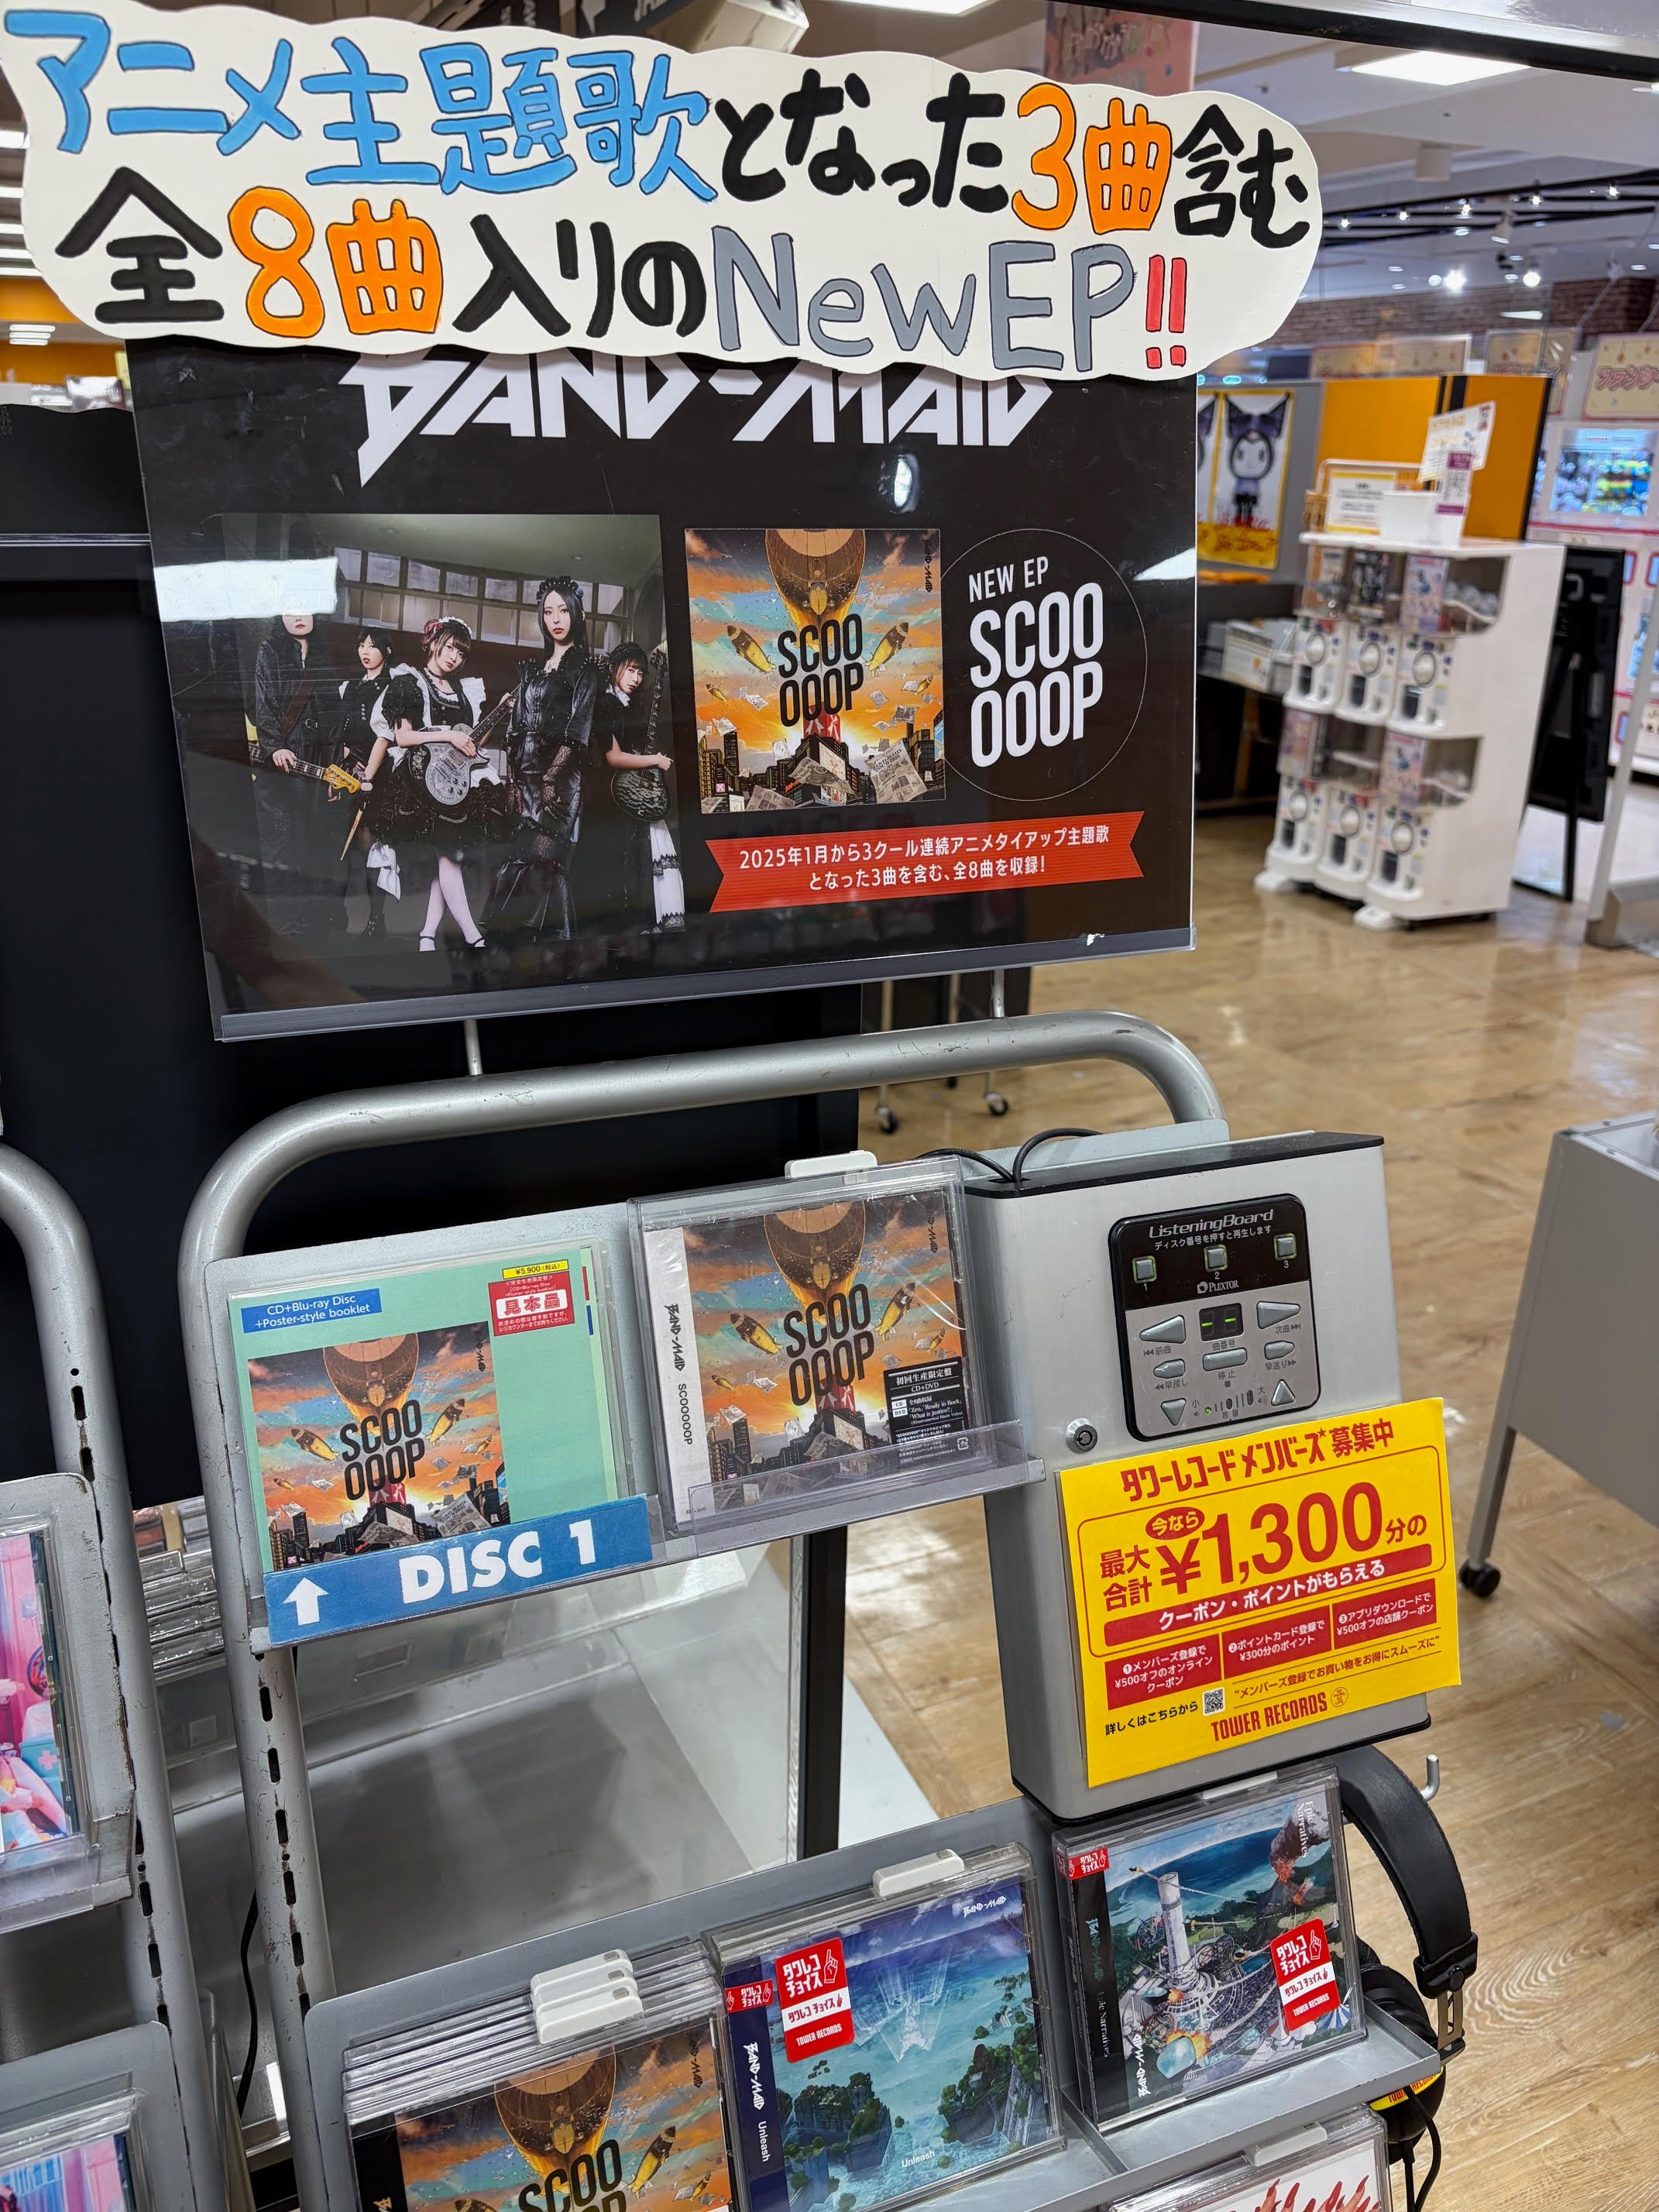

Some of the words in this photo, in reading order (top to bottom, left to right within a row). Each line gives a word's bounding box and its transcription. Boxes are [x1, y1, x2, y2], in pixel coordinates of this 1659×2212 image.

[4, 9, 1310, 249] アニメ主題歌となった3曲含む
[968, 564, 1015, 603] NEW
[1024, 555, 1049, 589] EP
[777, 613, 864, 678] SCOO
[970, 582, 1104, 689] SCOO
[780, 662, 864, 727] OOOP
[970, 661, 1104, 768] OOOP
[740, 825, 1110, 870] 2025年1月から3クール連続アニメタイアップ主題歌
[809, 860, 1046, 891] となった3曲を含む、全8曲を収録!
[1149, 1208, 1274, 1239] ListeningBoard
[1154, 1224, 1271, 1251] ディスク番号を押すと再生します
[1214, 1271, 1220, 1280] 2
[1283, 1260, 1289, 1269] 3
[1143, 1283, 1148, 1291] 1
[1208, 1279, 1239, 1292] PLEXTOR
[255, 1310, 325, 1328] +Poster-style
[329, 1304, 370, 1318] booklet
[266, 1298, 329, 1315] CD+Blu-ray
[332, 1295, 356, 1306] Disc
[504, 1292, 560, 1316] 見本品
[783, 1284, 871, 1358] SCOO
[1275, 1324, 1290, 1334] 次曲
[1155, 1345, 1171, 1355] 前曲
[1212, 1340, 1235, 1351] 曲番号
[664, 1304, 685, 1372] BAND-MAID
[678, 1383, 693, 1445] SCOOOOOP
[788, 1331, 874, 1406] OOOP
[896, 1367, 953, 1386] 初回生産限定盤
[1265, 1360, 1287, 1371] 早送り
[911, 1382, 939, 1393] CD+DVD
[1164, 1379, 1187, 1389] 早戻し
[1258, 1386, 1266, 1395] 大
[1192, 1399, 1200, 1408] 小
[340, 1399, 422, 1462] SCOO
[343, 1437, 426, 1501] OOOP
[1152, 1510, 1202, 1539] 今なら
[398, 1531, 543, 1605] DISC
[569, 1519, 596, 1565] 1
[1100, 1544, 1151, 1579] 最大
[1103, 1575, 1152, 1612] 合計
[1159, 1559, 1385, 1631] クーポン・ポイントがもらえる
[1337, 1604, 1434, 1636] ¥500オフの店舗クーポン
[1240, 1636, 1315, 1661] ¥300分のポイント
[1115, 1656, 1213, 1688] ¥500オフのオンライン
[1147, 1676, 1184, 1693] クーポン
[1105, 1701, 1199, 1736] 詳しくはこちらから
[1211, 1710, 1261, 1742] TOWER
[1263, 1692, 1328, 1727] RECORDS
[1304, 1801, 1315, 1824] Epic
[1297, 1803, 1309, 1858] Narratives
[1080, 1852, 1098, 1863] タワレコ
[1081, 1861, 1099, 1874] チョイス
[963, 1894, 1007, 1918] BAND-MAID
[1276, 1935, 1308, 1961] タワレコ
[782, 1953, 822, 1980] タワレコ
[1279, 1951, 1310, 1976] チョイス
[740, 1985, 762, 1997] タワレコ
[785, 1971, 823, 1998] チョイス
[1284, 1980, 1304, 1997] タワレコ
[1303, 1971, 1323, 1987] チョイス
[741, 1995, 763, 2008] チョイス
[788, 2006, 812, 2023] タワレコ
[812, 1997, 836, 2014] チョイス
[1293, 2004, 1309, 2017] TOWER
[1308, 1993, 1330, 2009] RECORDS
[796, 2032, 816, 2046] TOWER
[816, 2023, 842, 2039] RECORDS
[1132, 2033, 1152, 2098] BAND-MAID
[743, 2041, 765, 2111] BAND-MAID
[757, 2121, 771, 2162] Unleash
[901, 2148, 936, 2169] Unleash
